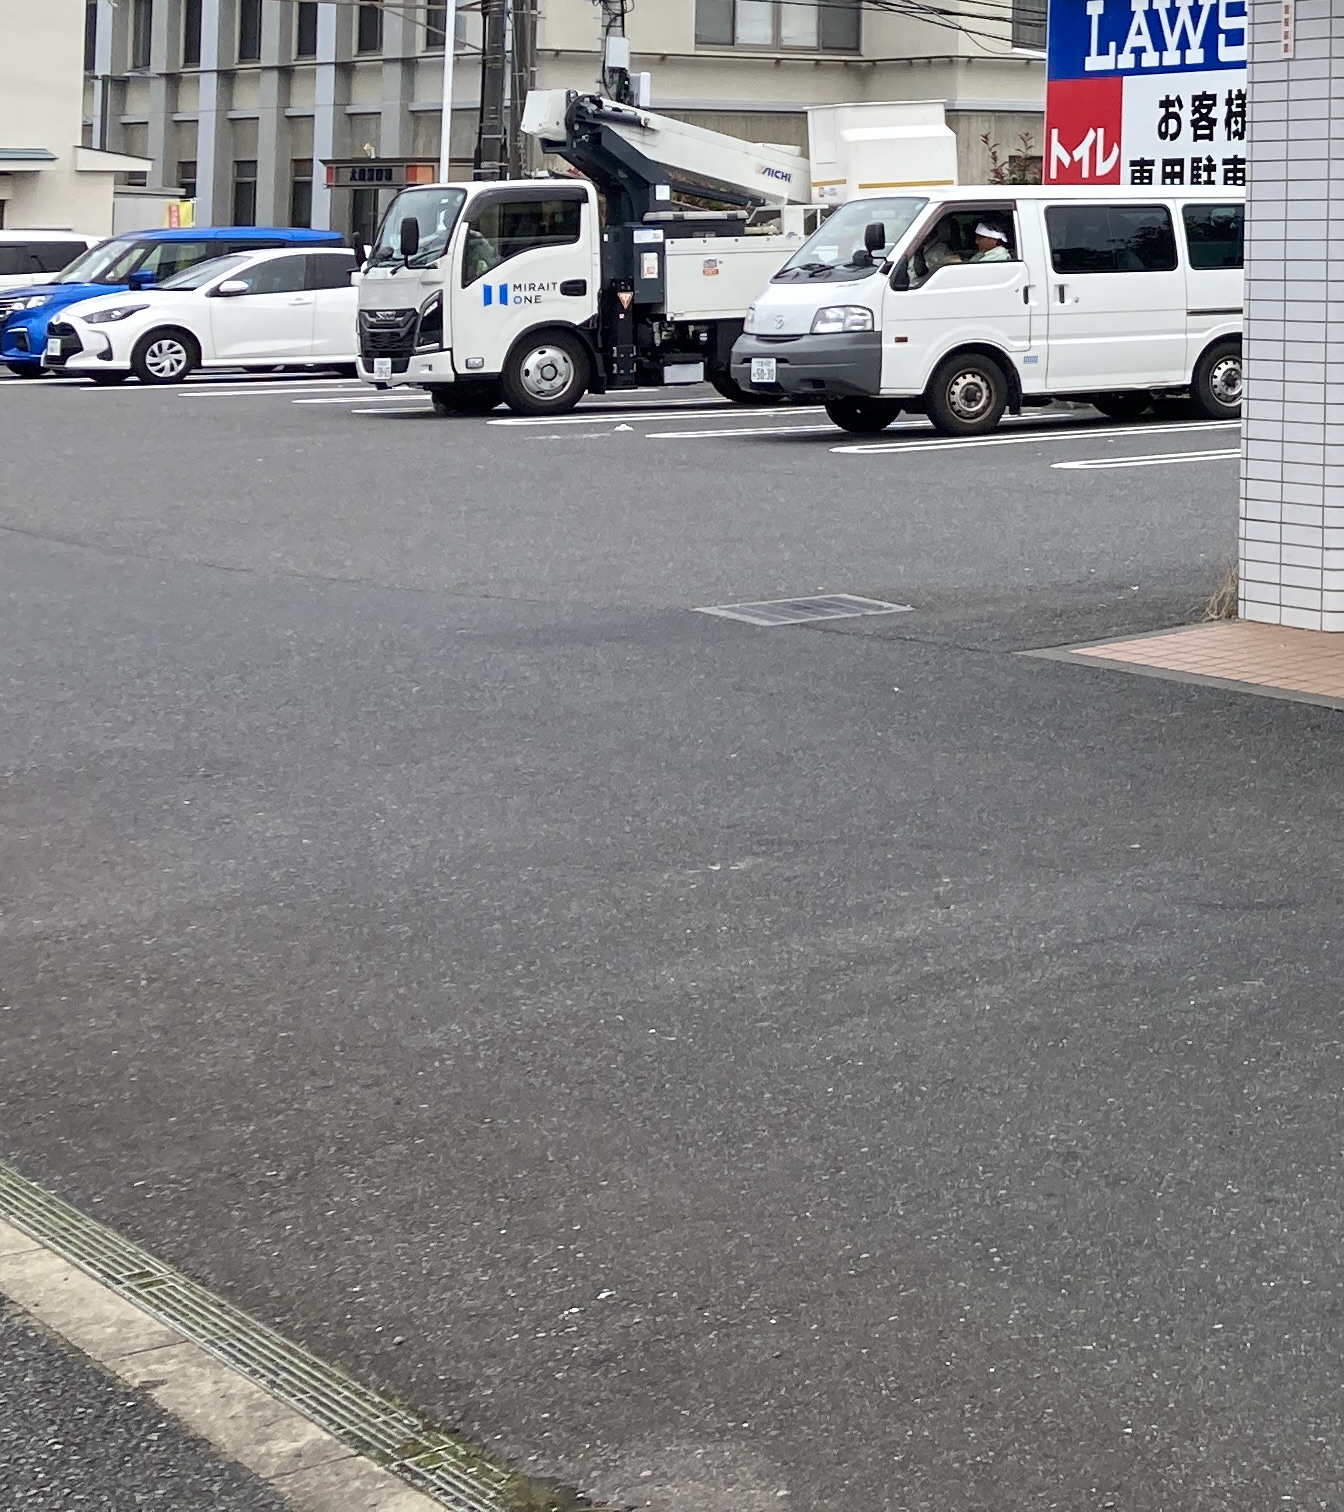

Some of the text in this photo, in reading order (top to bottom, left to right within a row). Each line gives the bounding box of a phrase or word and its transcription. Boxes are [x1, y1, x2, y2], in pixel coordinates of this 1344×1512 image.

[1158, 88, 1247, 142] お客様
[1049, 127, 1120, 180] トイレ
[512, 282, 558, 292] MIRAIT
[513, 295, 542, 305] ONE
